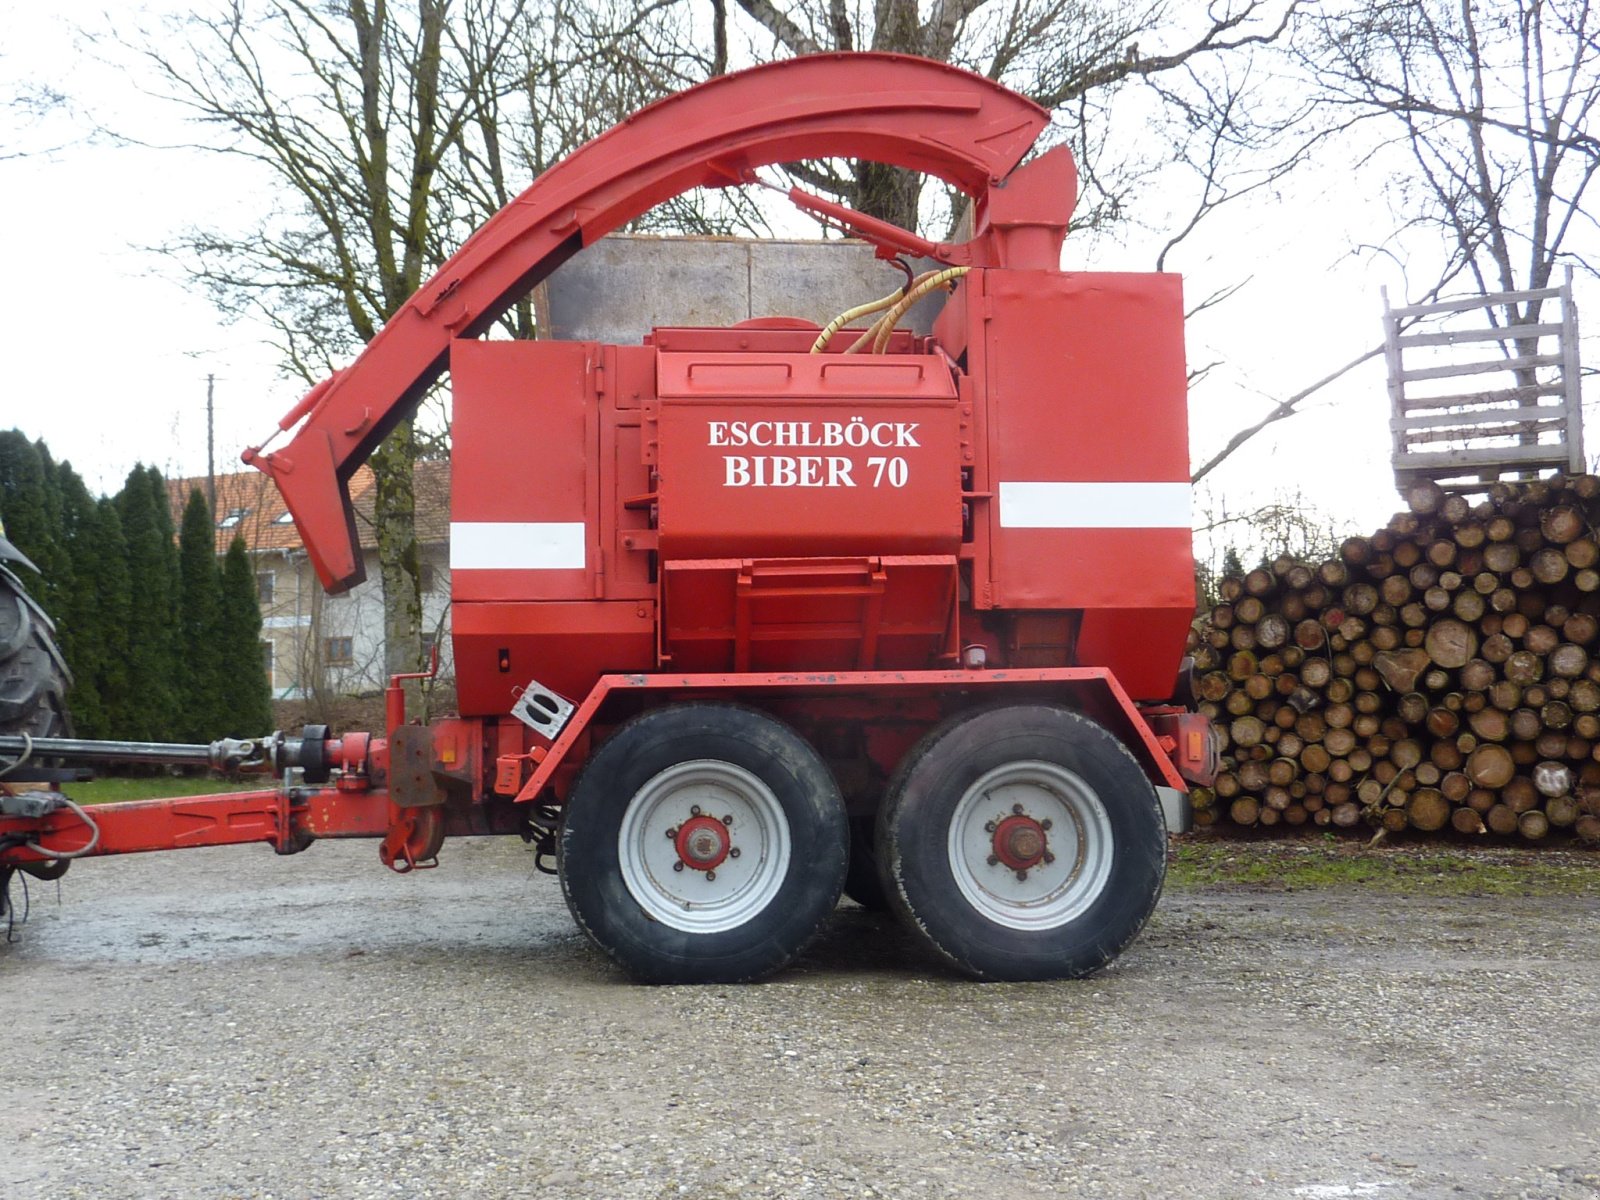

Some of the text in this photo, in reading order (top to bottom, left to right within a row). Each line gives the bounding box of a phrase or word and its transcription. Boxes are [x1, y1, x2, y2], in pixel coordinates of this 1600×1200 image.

[706, 415, 921, 447] ESCHLBÖCK
[722, 455, 909, 488] BIBER 70
